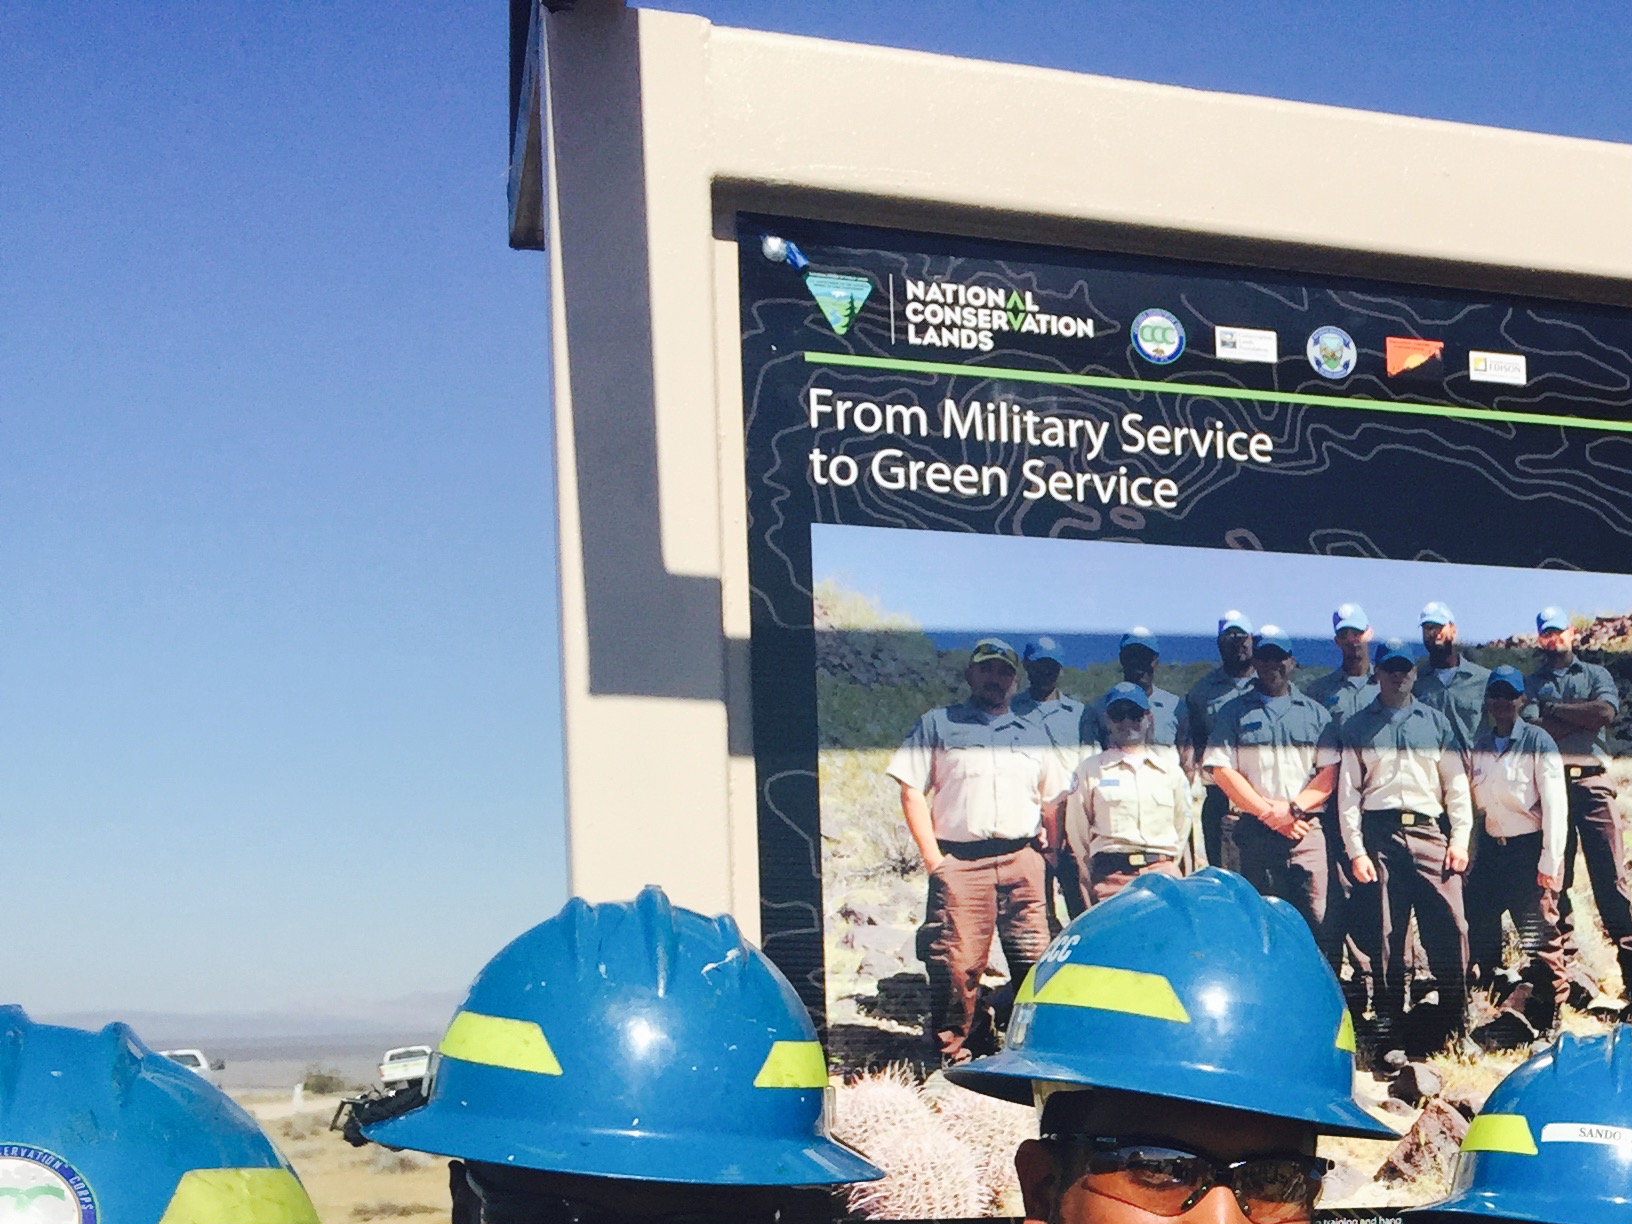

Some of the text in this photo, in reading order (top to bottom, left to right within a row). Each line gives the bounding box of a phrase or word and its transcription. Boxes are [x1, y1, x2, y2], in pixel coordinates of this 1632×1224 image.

[906, 279, 1039, 314] NATIONAL
[906, 302, 1095, 339] CONSERVATION
[908, 325, 995, 352] LANDS
[809, 388, 1274, 463] From Military Service
[809, 448, 1179, 508] to Green Service
[69, 1176, 95, 1211] CORPS
